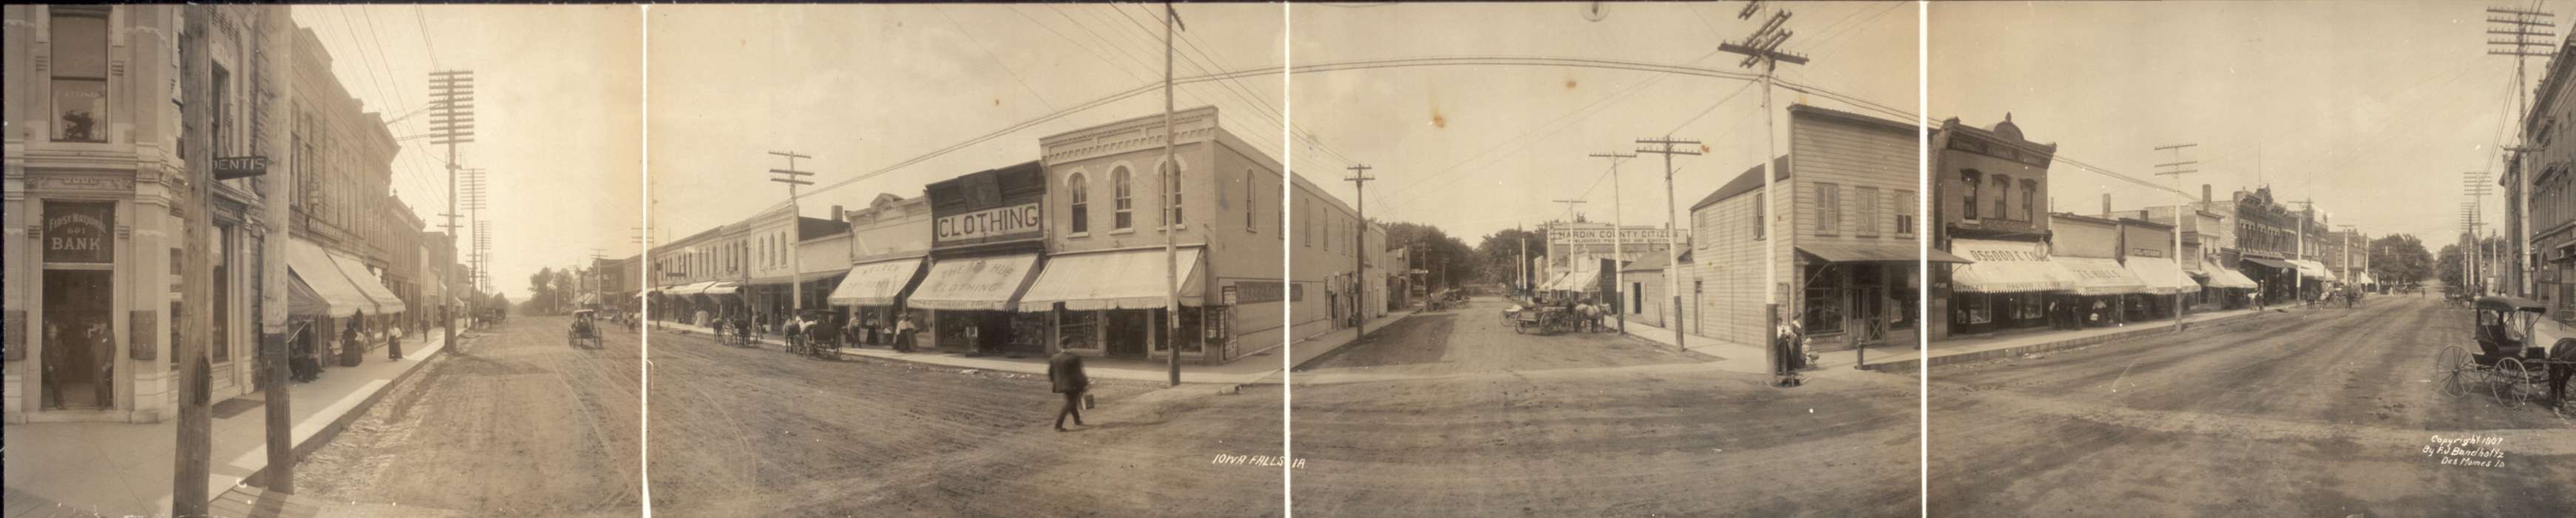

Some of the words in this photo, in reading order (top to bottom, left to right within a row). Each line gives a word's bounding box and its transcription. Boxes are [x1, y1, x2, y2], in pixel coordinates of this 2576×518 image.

[49, 215, 72, 232] FIRST
[72, 212, 106, 234] NATIONAL
[939, 206, 1038, 238] CLOTHING
[1559, 230, 1595, 238] HARDIN
[51, 237, 101, 251] BANK
[1970, 250, 2016, 261] OSGOOD
[992, 263, 1014, 278] HUB
[932, 283, 1000, 292] CLOTHING
